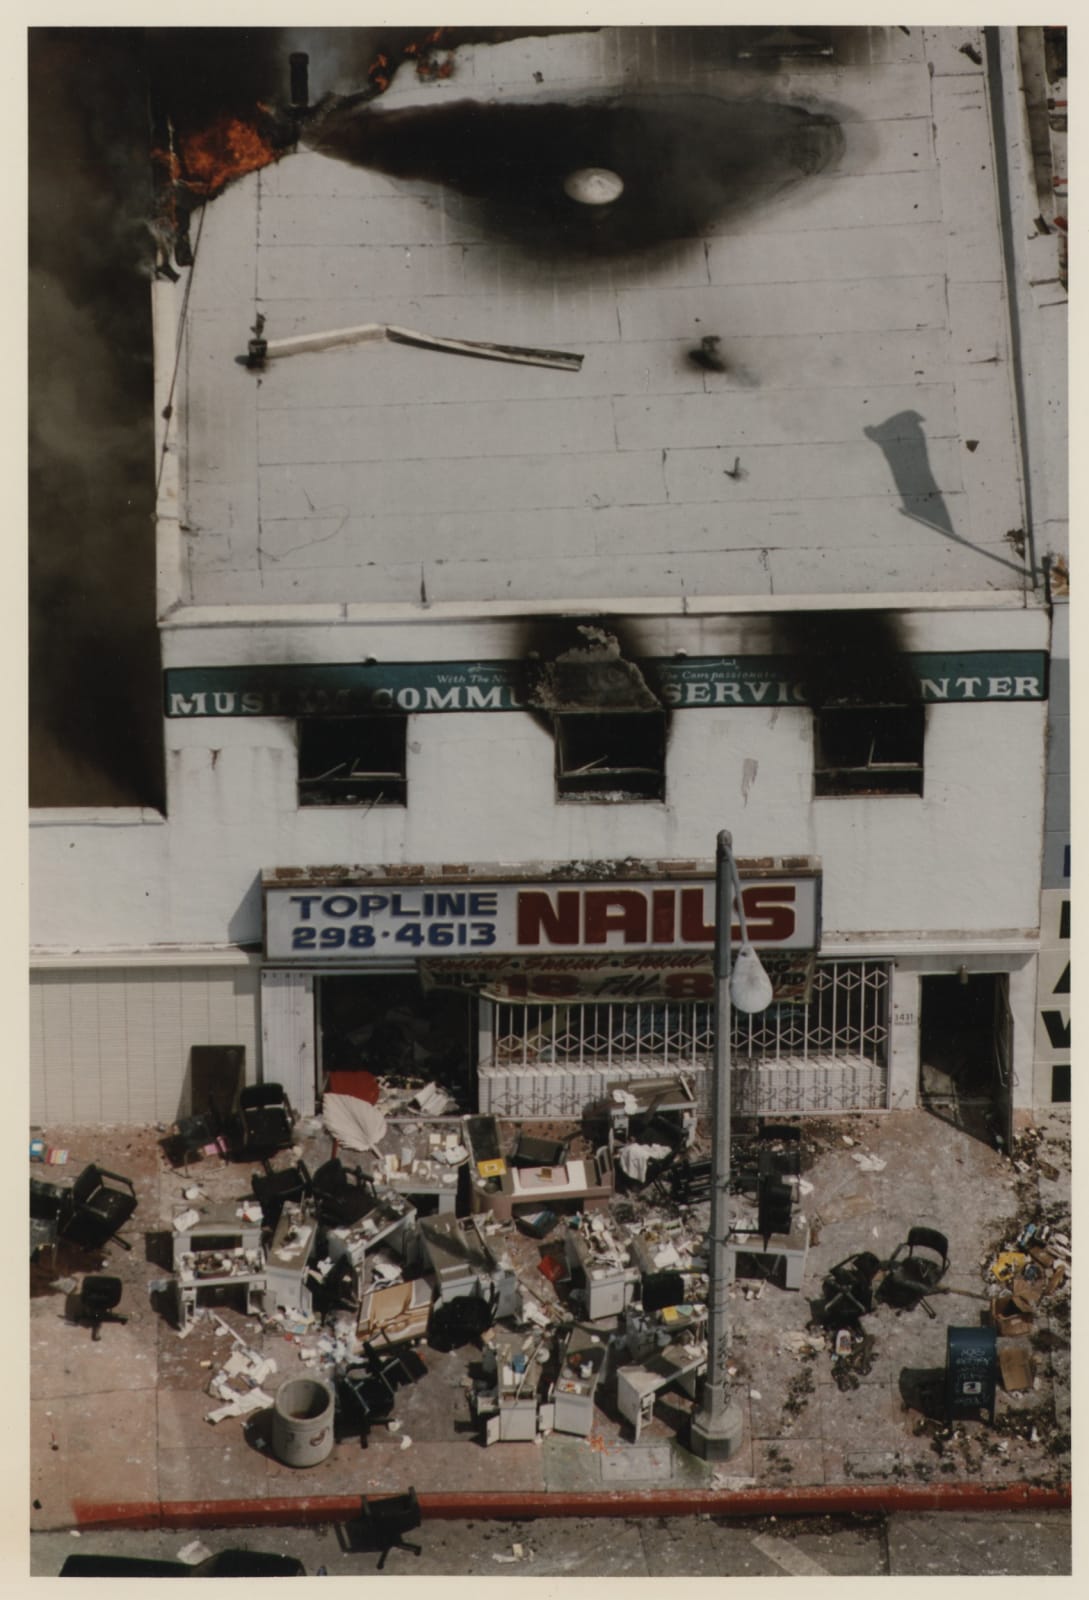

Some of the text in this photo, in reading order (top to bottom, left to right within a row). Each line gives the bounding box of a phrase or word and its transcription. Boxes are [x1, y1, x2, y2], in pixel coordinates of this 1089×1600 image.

[437, 674, 466, 684] With
[470, 673, 489, 683] The
[290, 892, 497, 919] TOPLINE
[517, 886, 796, 945] NAILS
[621, 952, 710, 971] Special
